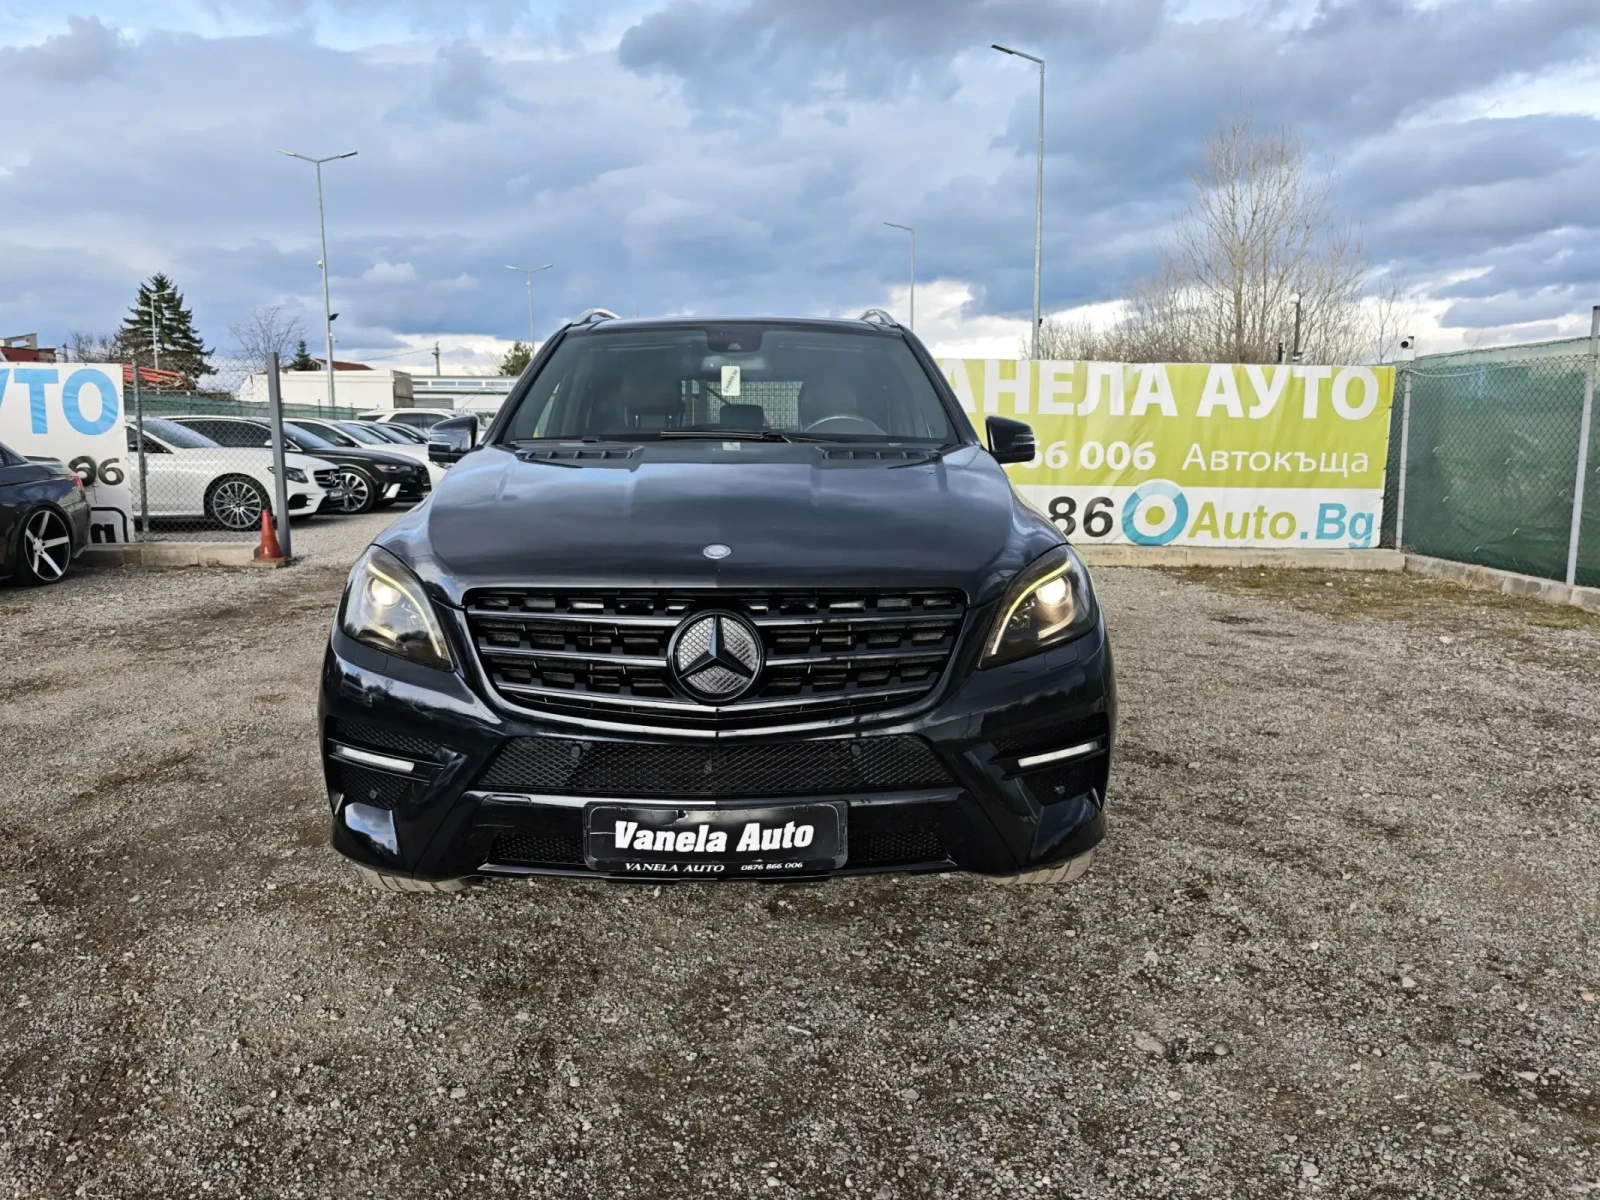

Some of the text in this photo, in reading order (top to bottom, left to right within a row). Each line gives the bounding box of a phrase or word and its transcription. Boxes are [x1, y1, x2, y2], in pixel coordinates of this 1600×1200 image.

[1196, 364, 1379, 420] АУТО
[1080, 441, 1156, 470] 006
[1181, 443, 1369, 478] Автокъща
[1048, 496, 1114, 538] 86
[615, 820, 814, 852] Vanela Auto
[625, 862, 678, 872] VANELA
[683, 864, 725, 872] AUTO
